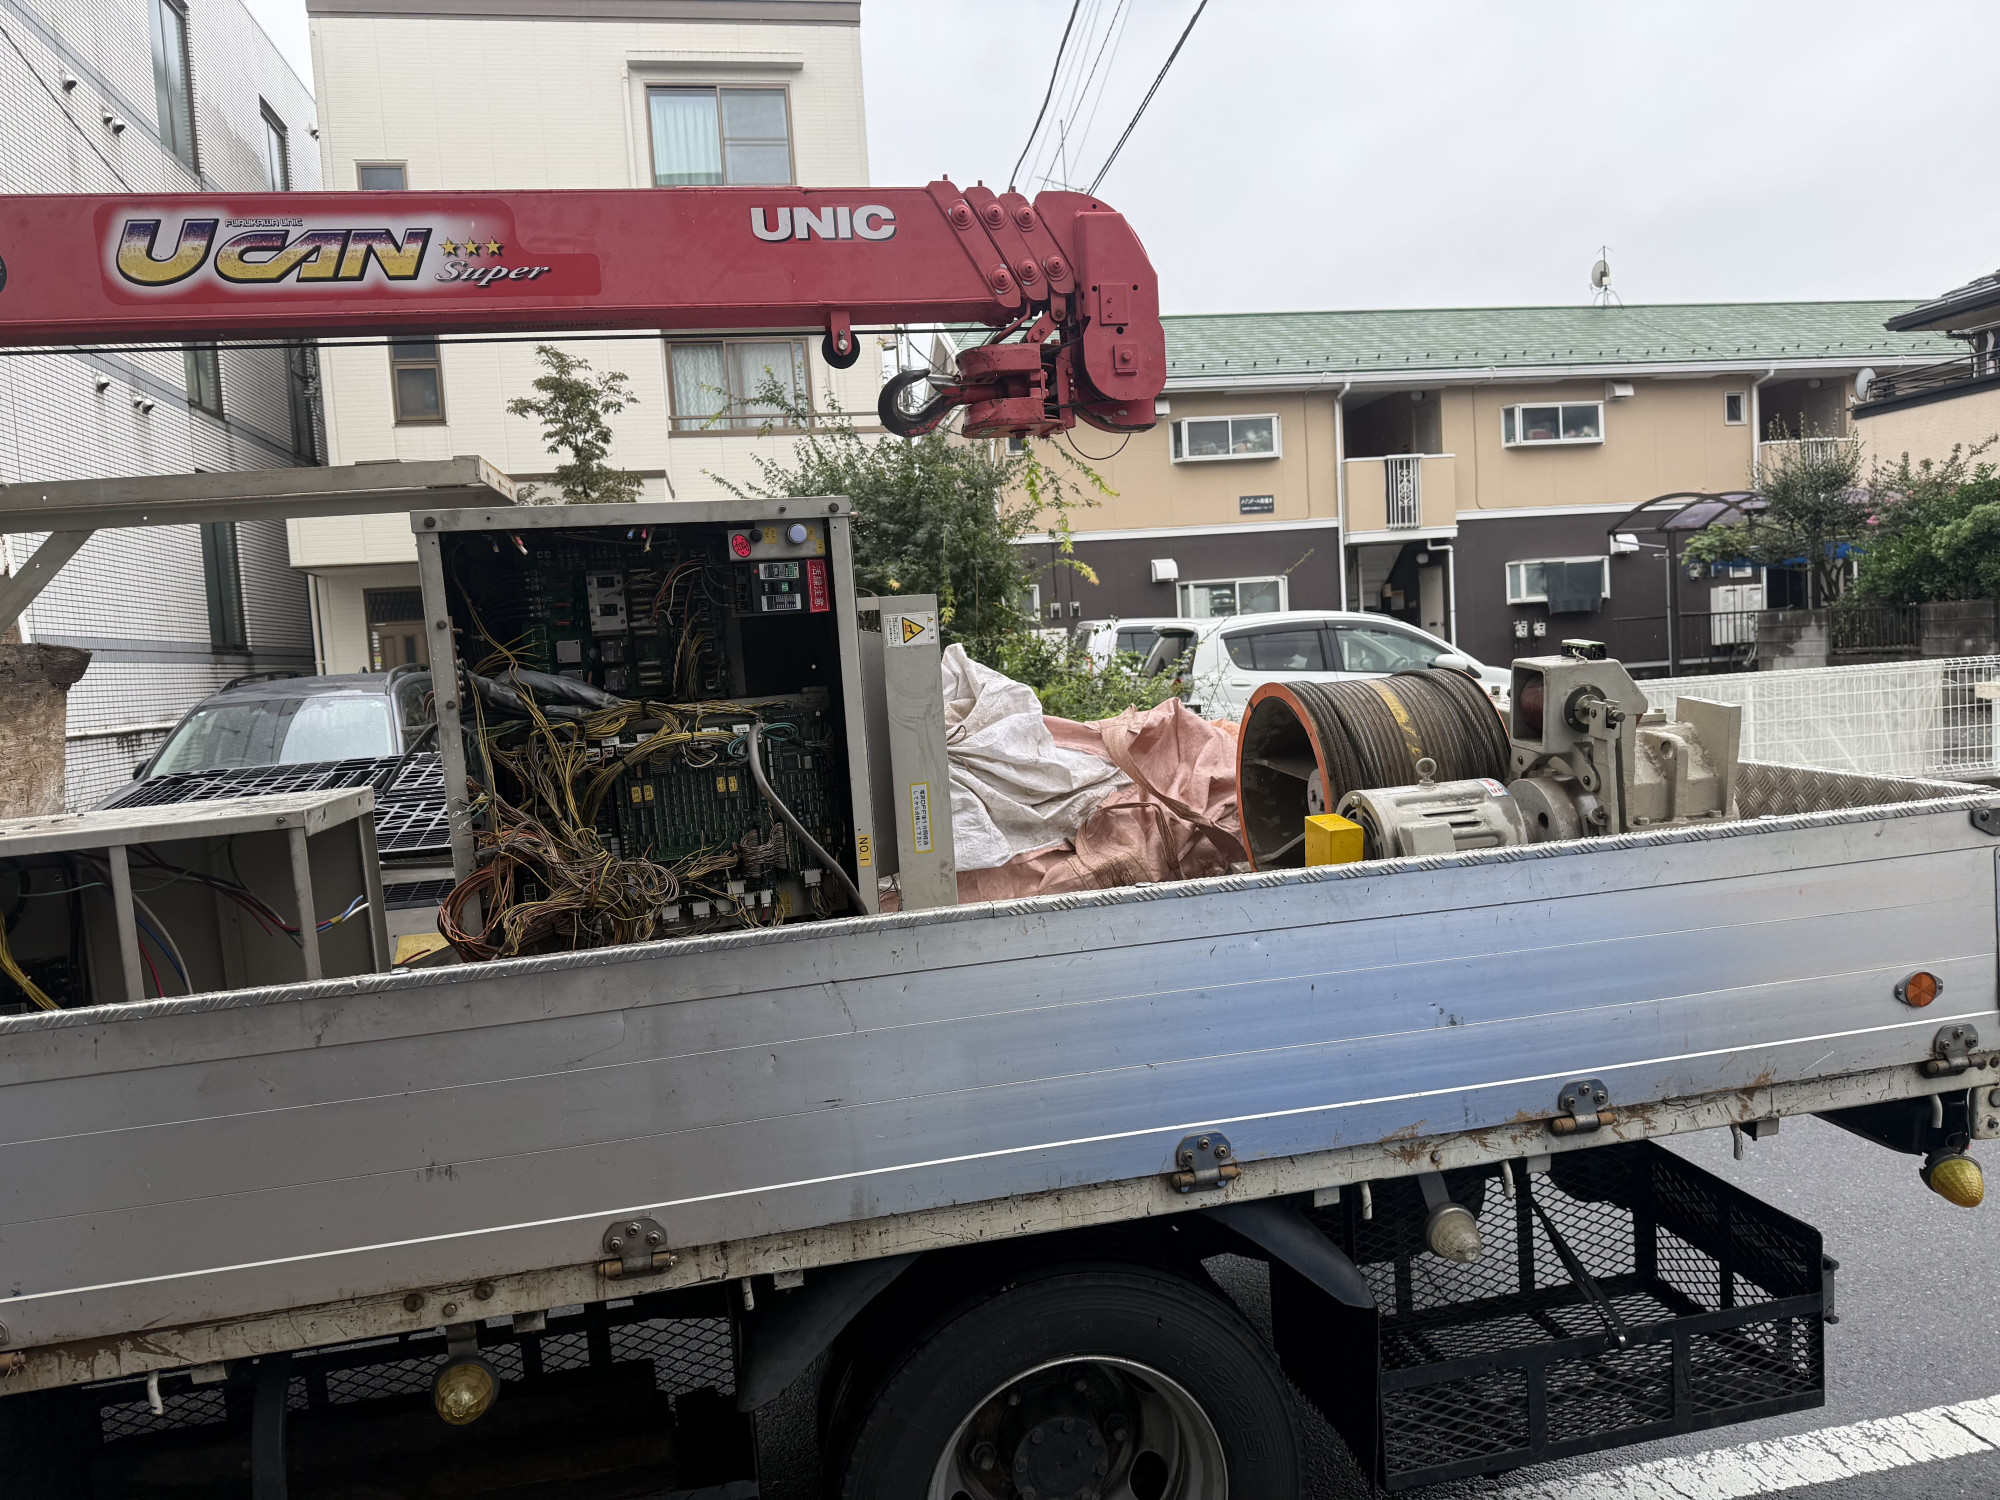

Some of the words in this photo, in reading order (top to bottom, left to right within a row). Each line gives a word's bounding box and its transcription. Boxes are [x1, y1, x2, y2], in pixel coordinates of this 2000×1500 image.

[225, 218, 279, 228] FURUKAWA
[280, 218, 303, 227] UNIC
[750, 204, 897, 242] UNIC
[434, 259, 550, 287] Super
